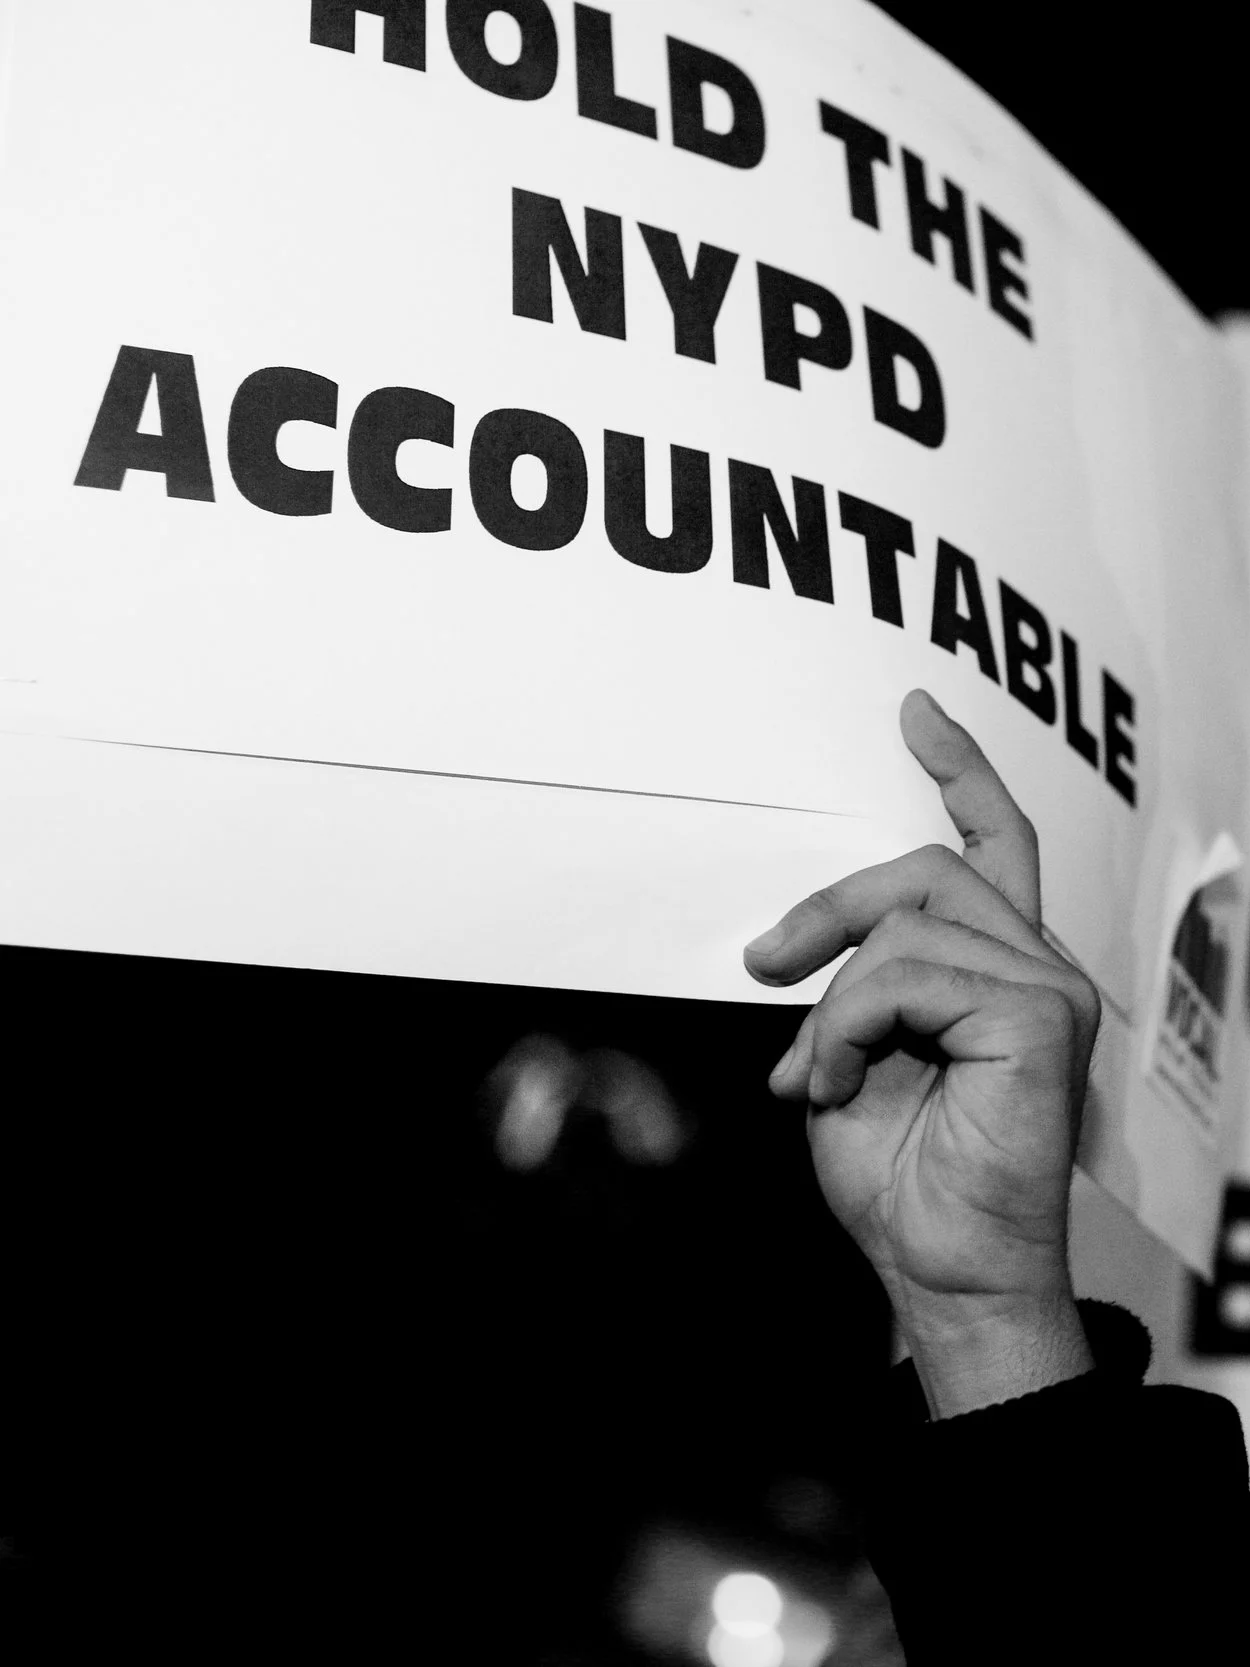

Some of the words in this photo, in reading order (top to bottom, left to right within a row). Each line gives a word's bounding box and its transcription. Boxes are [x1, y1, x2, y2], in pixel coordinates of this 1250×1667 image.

[511, 187, 947, 450] NYPD
[818, 99, 1034, 342] THE
[73, 344, 1139, 811] ACCOUNTABLE
